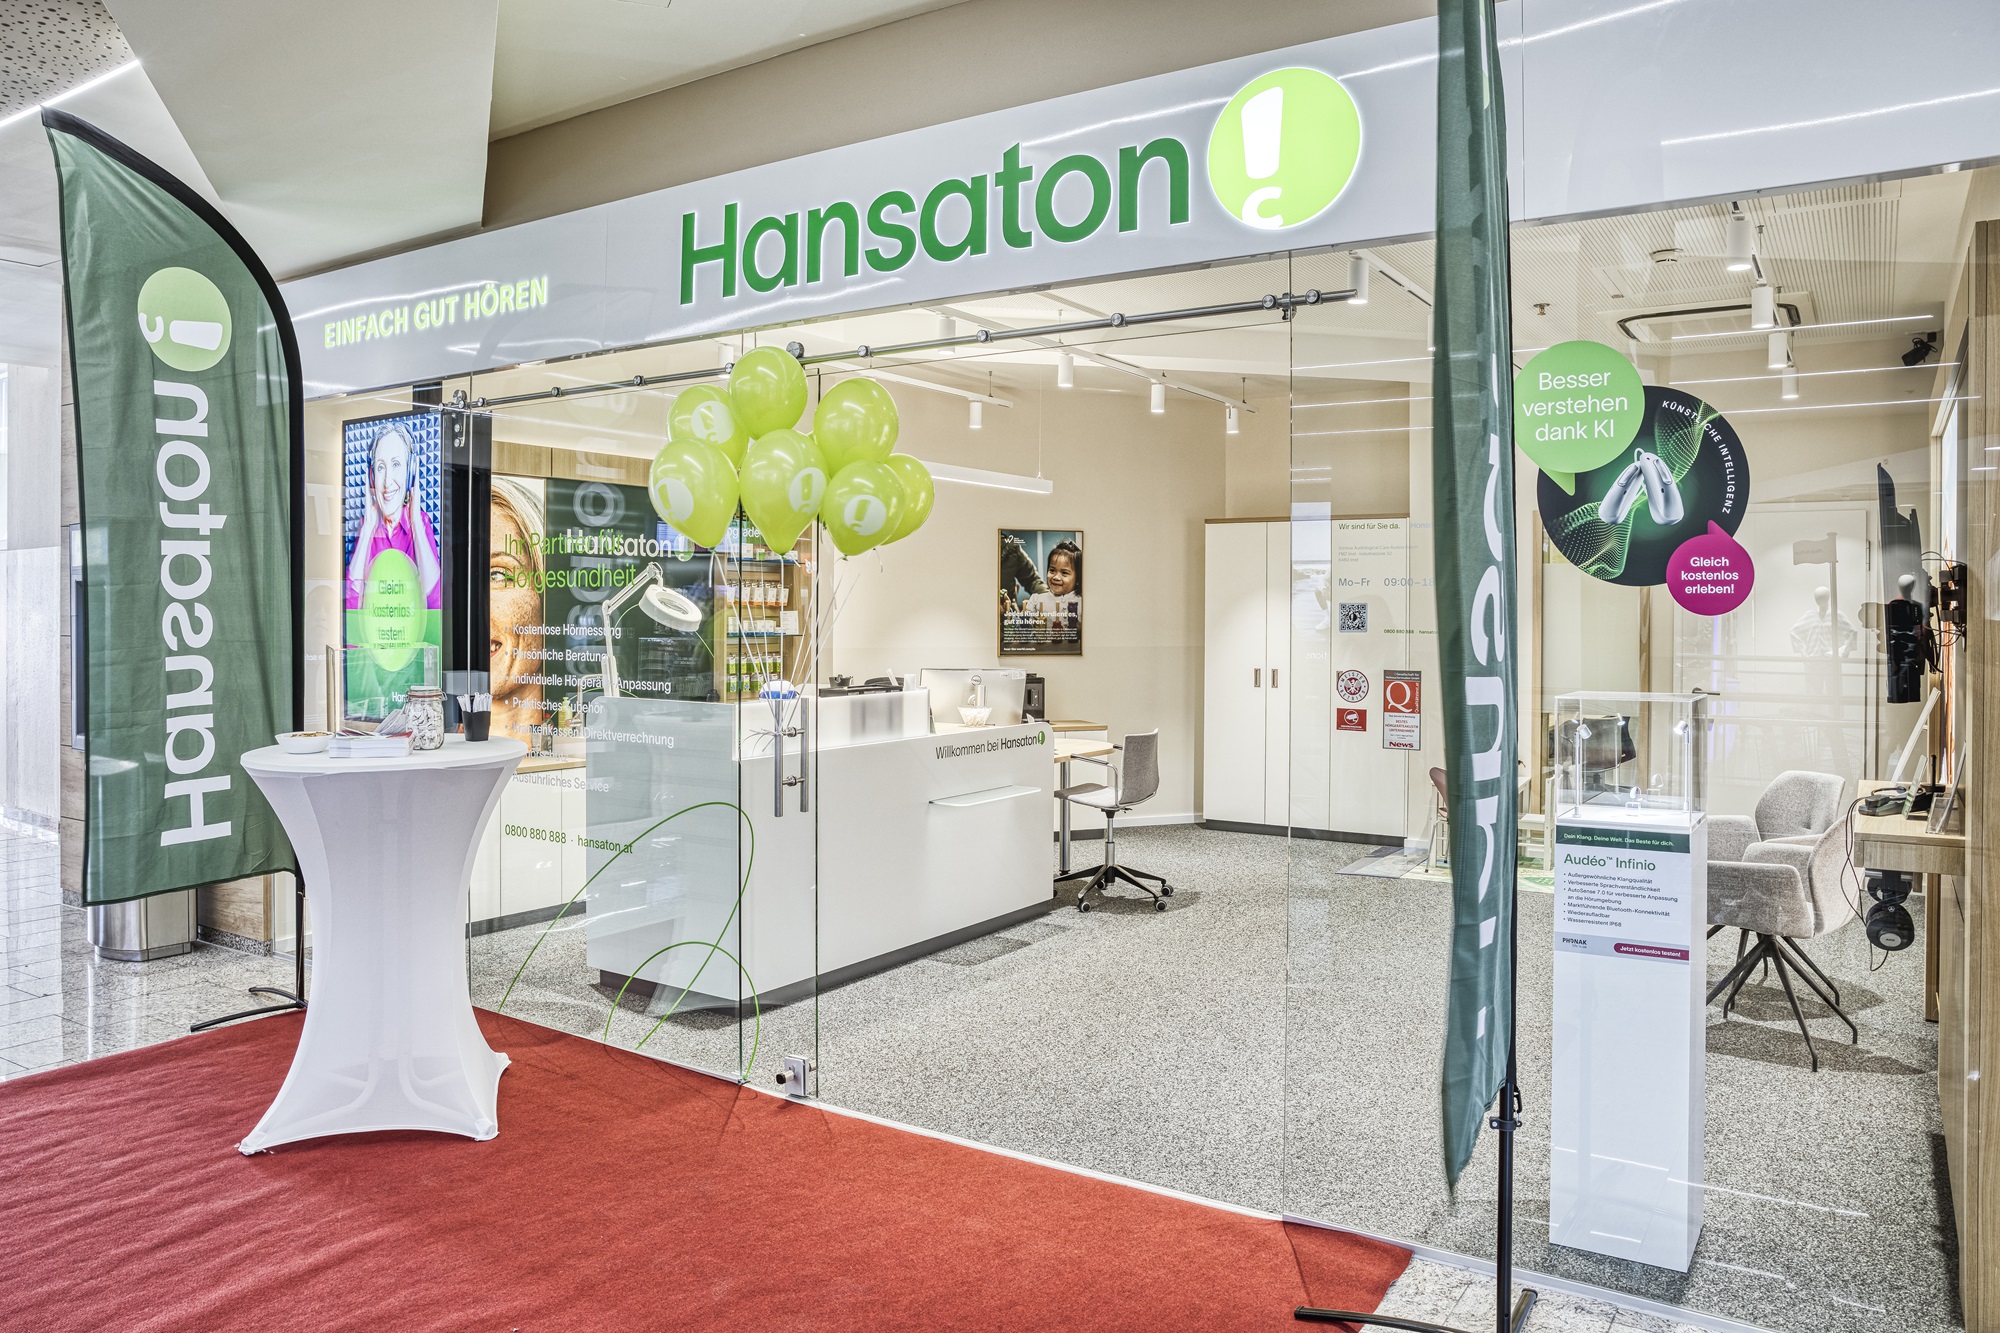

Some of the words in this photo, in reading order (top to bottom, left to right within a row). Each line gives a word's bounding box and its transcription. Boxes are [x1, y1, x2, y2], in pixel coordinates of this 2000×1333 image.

[680, 137, 1190, 305] Hansaton
[324, 306, 408, 348] EINFACH
[414, 296, 457, 330] GUT
[465, 277, 548, 322] HÖREN
[1538, 371, 1611, 391] Besser
[1522, 395, 1628, 417] verstehen
[1535, 422, 1588, 442] dank
[1594, 420, 1614, 438] KI
[1718, 442, 1736, 514] INTELLIGENZ
[504, 533, 524, 556] Ihr
[530, 532, 592, 554] Partner
[599, 528, 623, 553] für
[1690, 556, 1729, 568] Gleich
[504, 562, 637, 594] Hörgesundheit
[1681, 570, 1739, 581] kostenlos
[1685, 583, 1735, 594] erleben!
[513, 624, 560, 636] Kostenlose
[513, 648, 563, 662] Persönliche
[513, 674, 562, 686] Individuelle
[1386, 681, 1412, 713] Q
[513, 698, 562, 712] Praktisches
[936, 742, 985, 760] Willkommen
[987, 739, 999, 752] bei
[1001, 735, 1037, 750] Hansaton
[512, 773, 571, 788] Ausführliches
[505, 824, 527, 838] 0800
[530, 828, 546, 840] 880
[549, 830, 566, 844] 888
[1616, 857, 1656, 871] Infinio
[1568, 872, 1616, 881] Außergewöhnliche
[1617, 876, 1652, 885] Klangqualität
[1600, 882, 1660, 893] Sprachverständlichkeit
[1584, 896, 1622, 905] Hörumgebung
[1648, 894, 1678, 902] Anpassung
[1567, 910, 1610, 918] Wiederaufladbar
[1606, 906, 1670, 917] Bluetooth-Konnektivität
[1567, 917, 1608, 926] Wasserresistent
